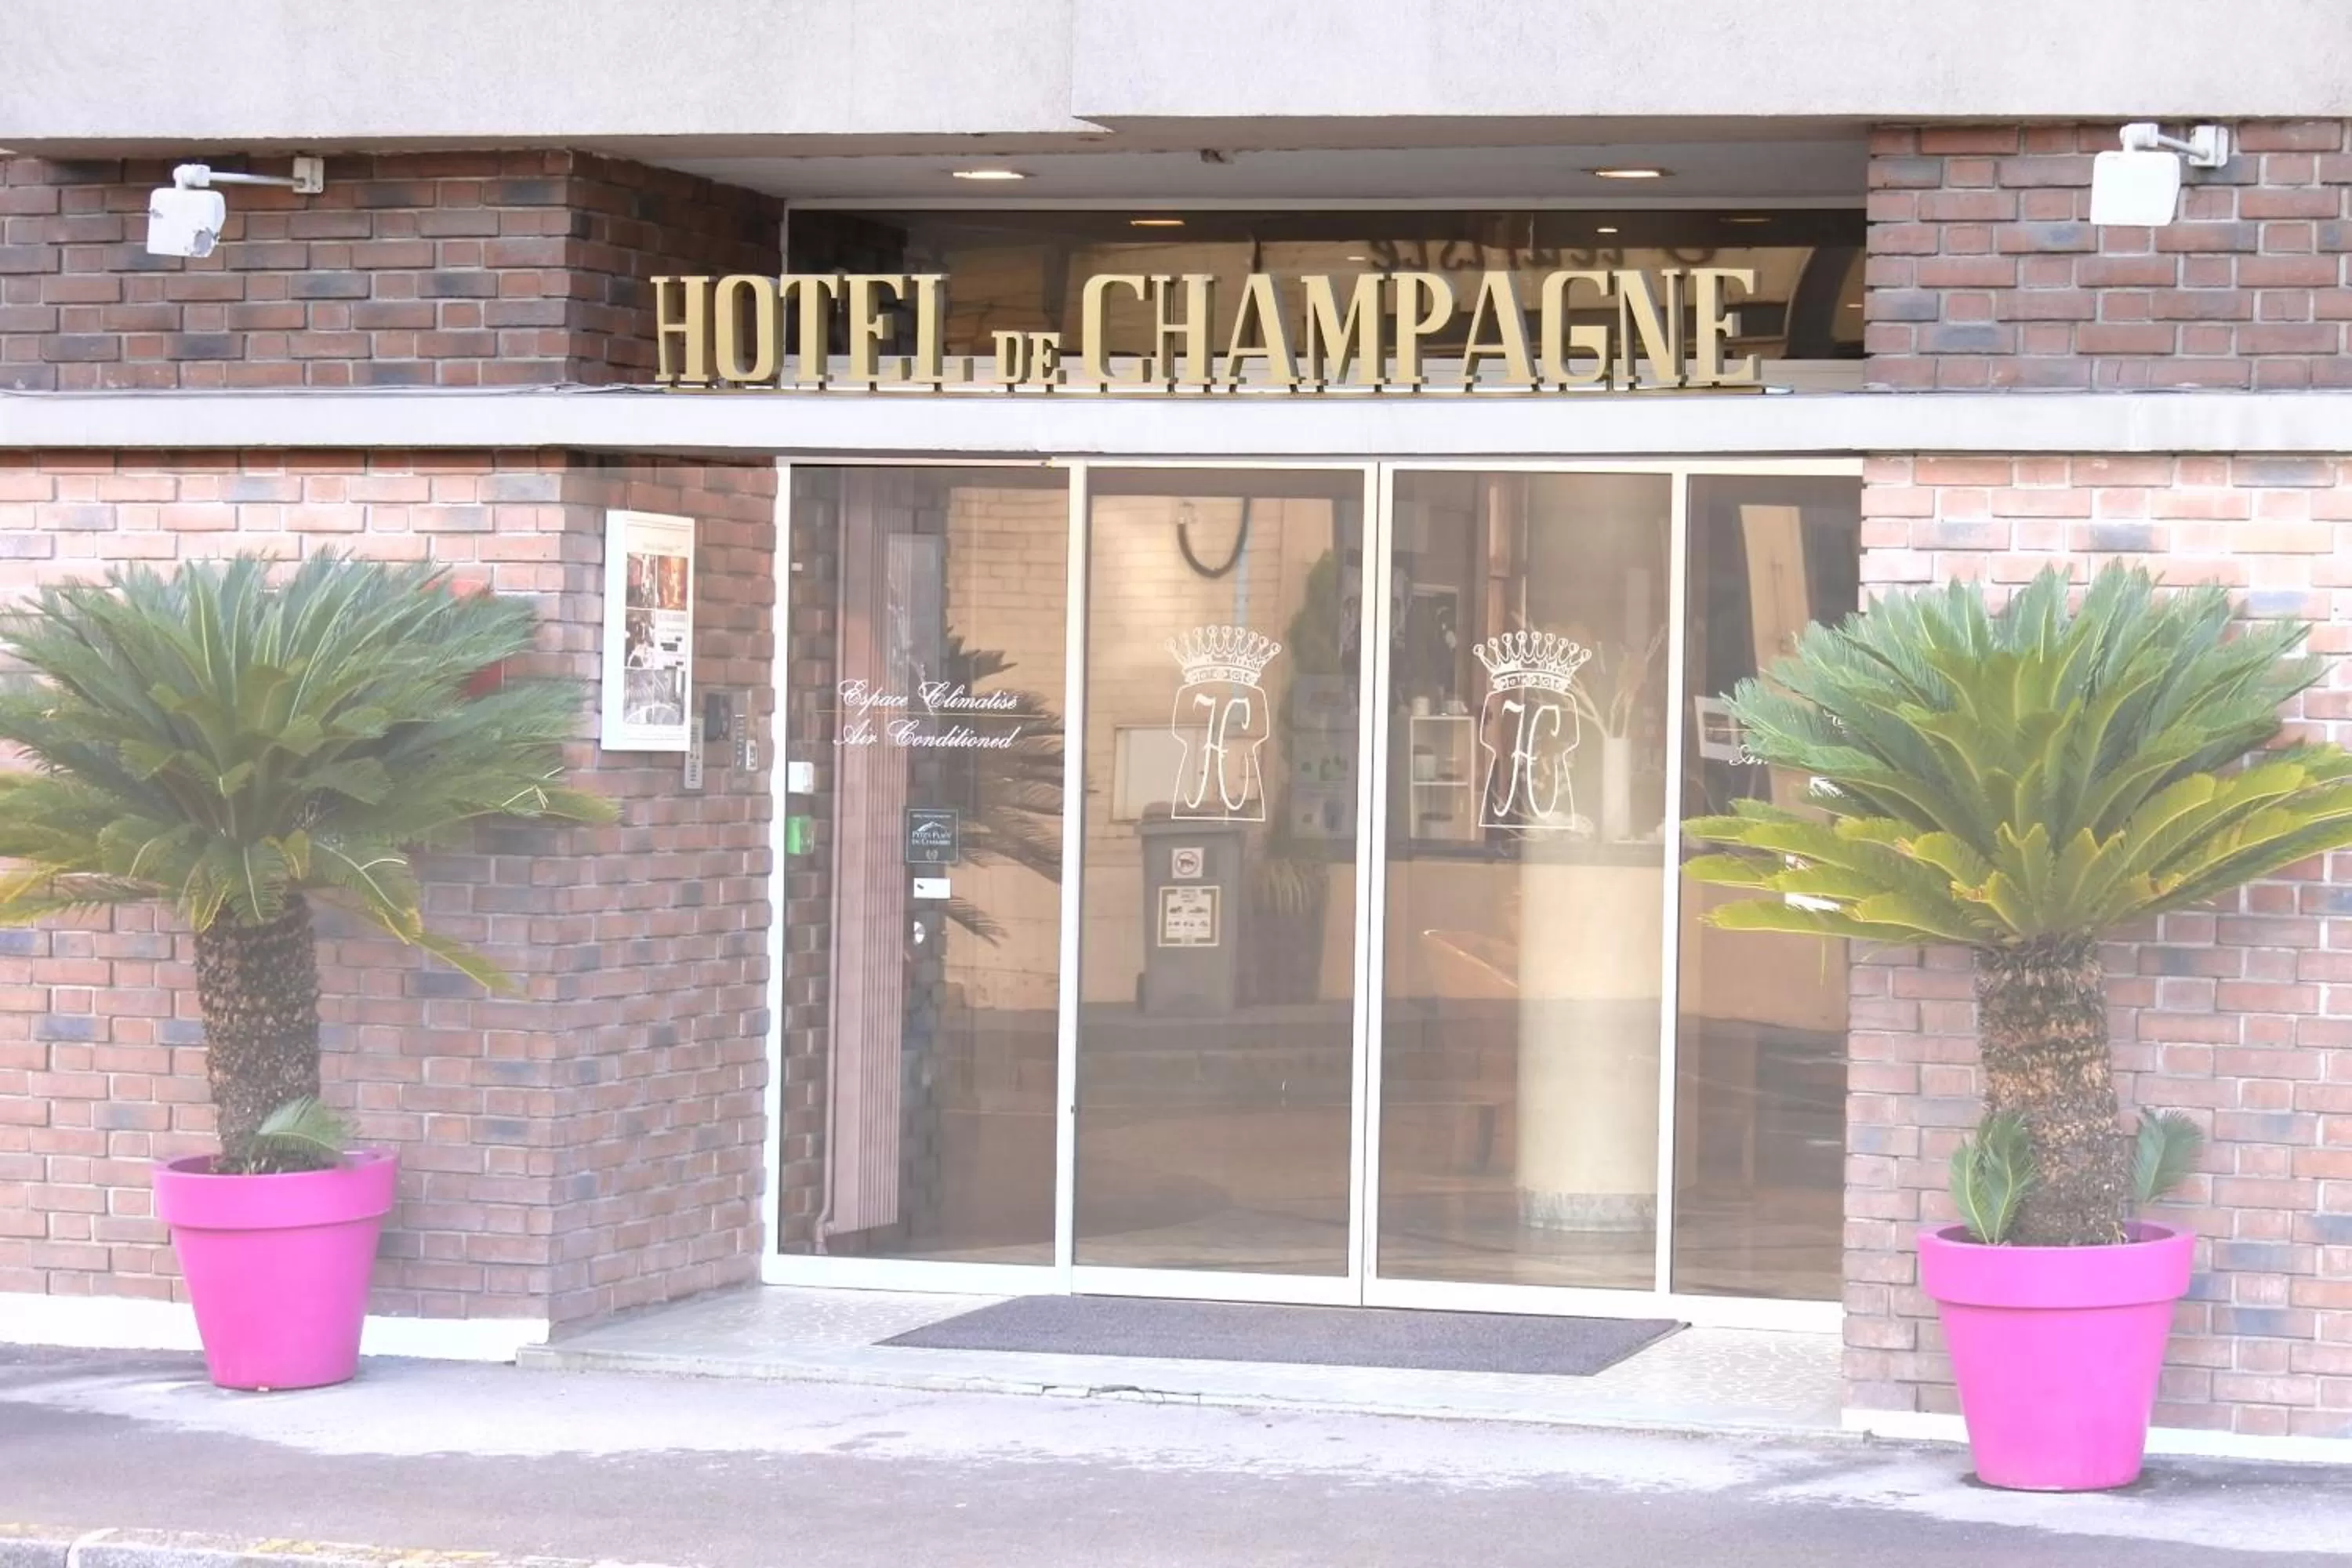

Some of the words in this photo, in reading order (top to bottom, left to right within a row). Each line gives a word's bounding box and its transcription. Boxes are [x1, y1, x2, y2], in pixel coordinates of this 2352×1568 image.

[650, 274, 975, 383] HOTEL
[991, 331, 1067, 385] DE
[1082, 267, 1762, 386] CHAMPAGNE
[838, 679, 908, 715] Espace
[833, 719, 878, 746] Air
[887, 719, 1022, 749] Conditioned
